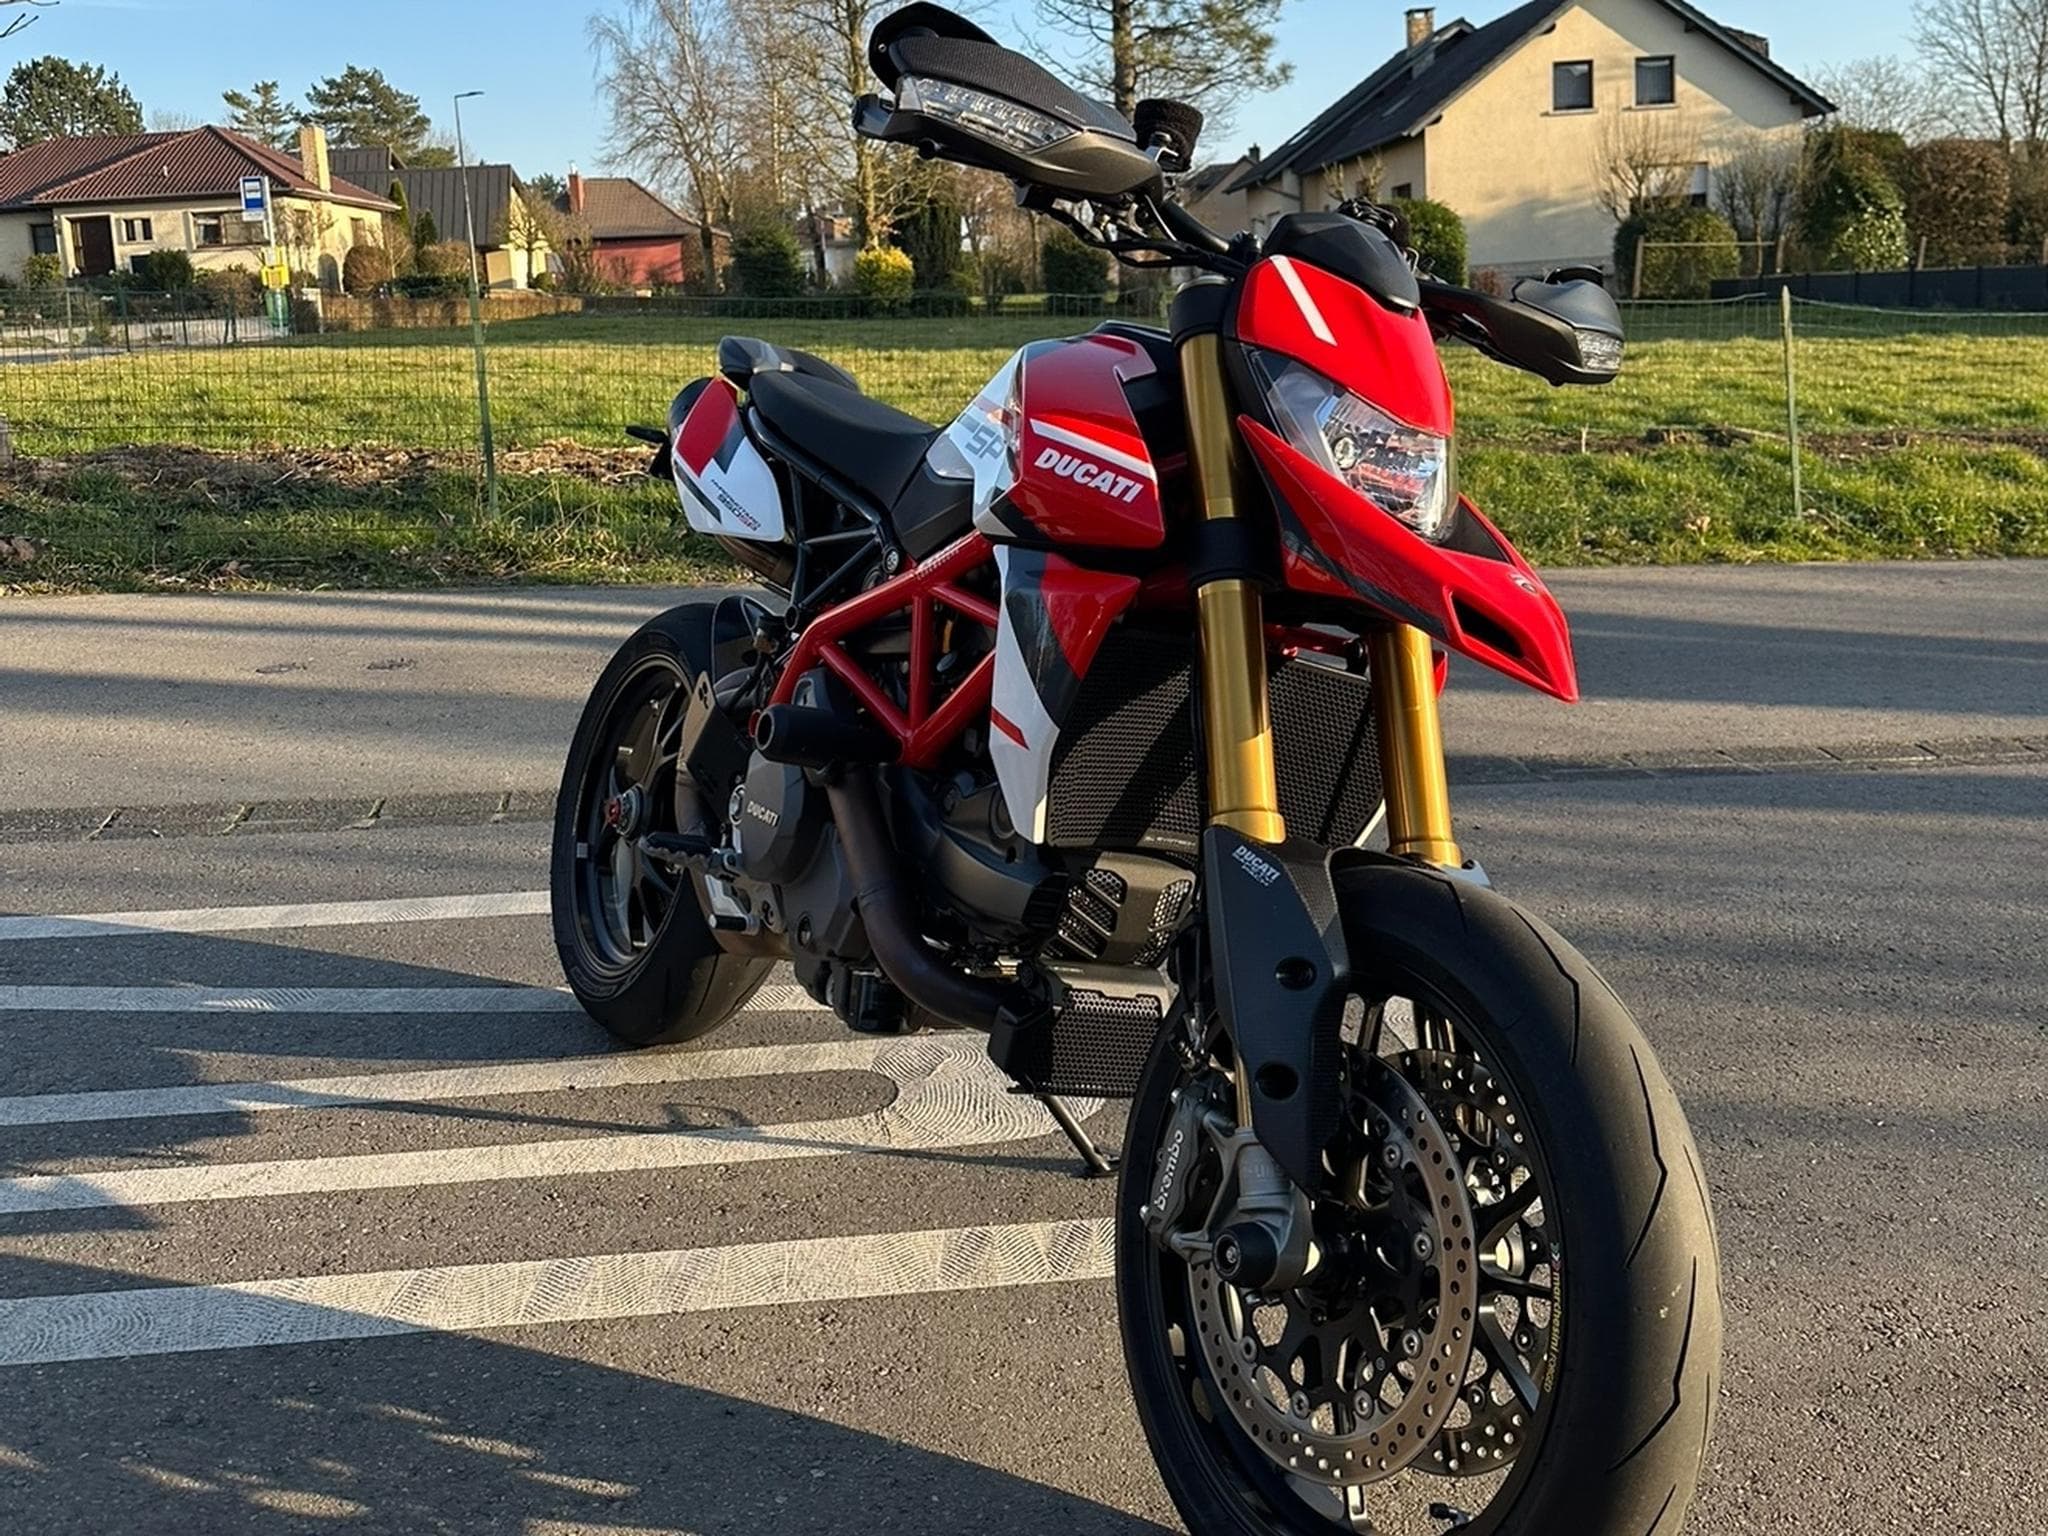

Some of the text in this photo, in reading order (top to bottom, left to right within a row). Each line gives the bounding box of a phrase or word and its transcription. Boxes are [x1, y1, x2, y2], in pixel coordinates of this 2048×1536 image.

[965, 424, 1005, 460] SP
[1034, 448, 1144, 503] DUCATI
[747, 800, 778, 826] DUCATI
[1235, 845, 1280, 880] DUCATI
[1154, 1129, 1184, 1211] brembo
[1550, 1271, 1562, 1352] marchesini
